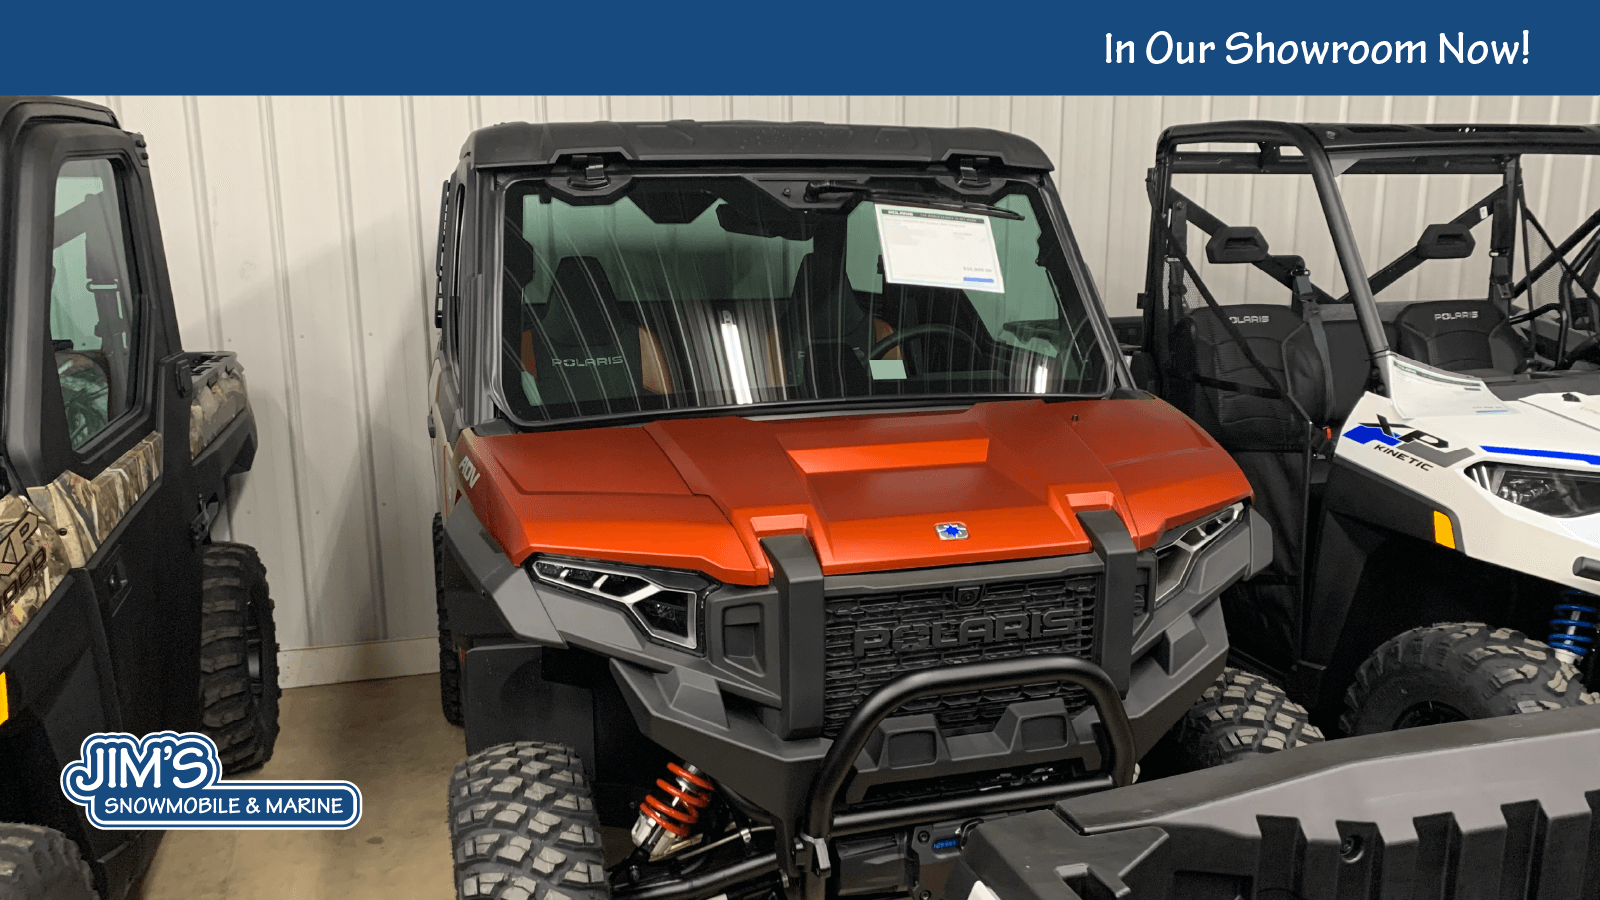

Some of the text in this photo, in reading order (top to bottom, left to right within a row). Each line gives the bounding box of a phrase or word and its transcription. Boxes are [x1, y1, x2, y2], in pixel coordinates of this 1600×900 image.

[1228, 315, 1270, 324] OLARIS
[1433, 310, 1479, 321] POLARIS
[551, 355, 624, 367] POLARIS
[1373, 444, 1434, 472] KINETIC
[458, 455, 481, 489] ADV
[853, 608, 1077, 658] POLARIS
